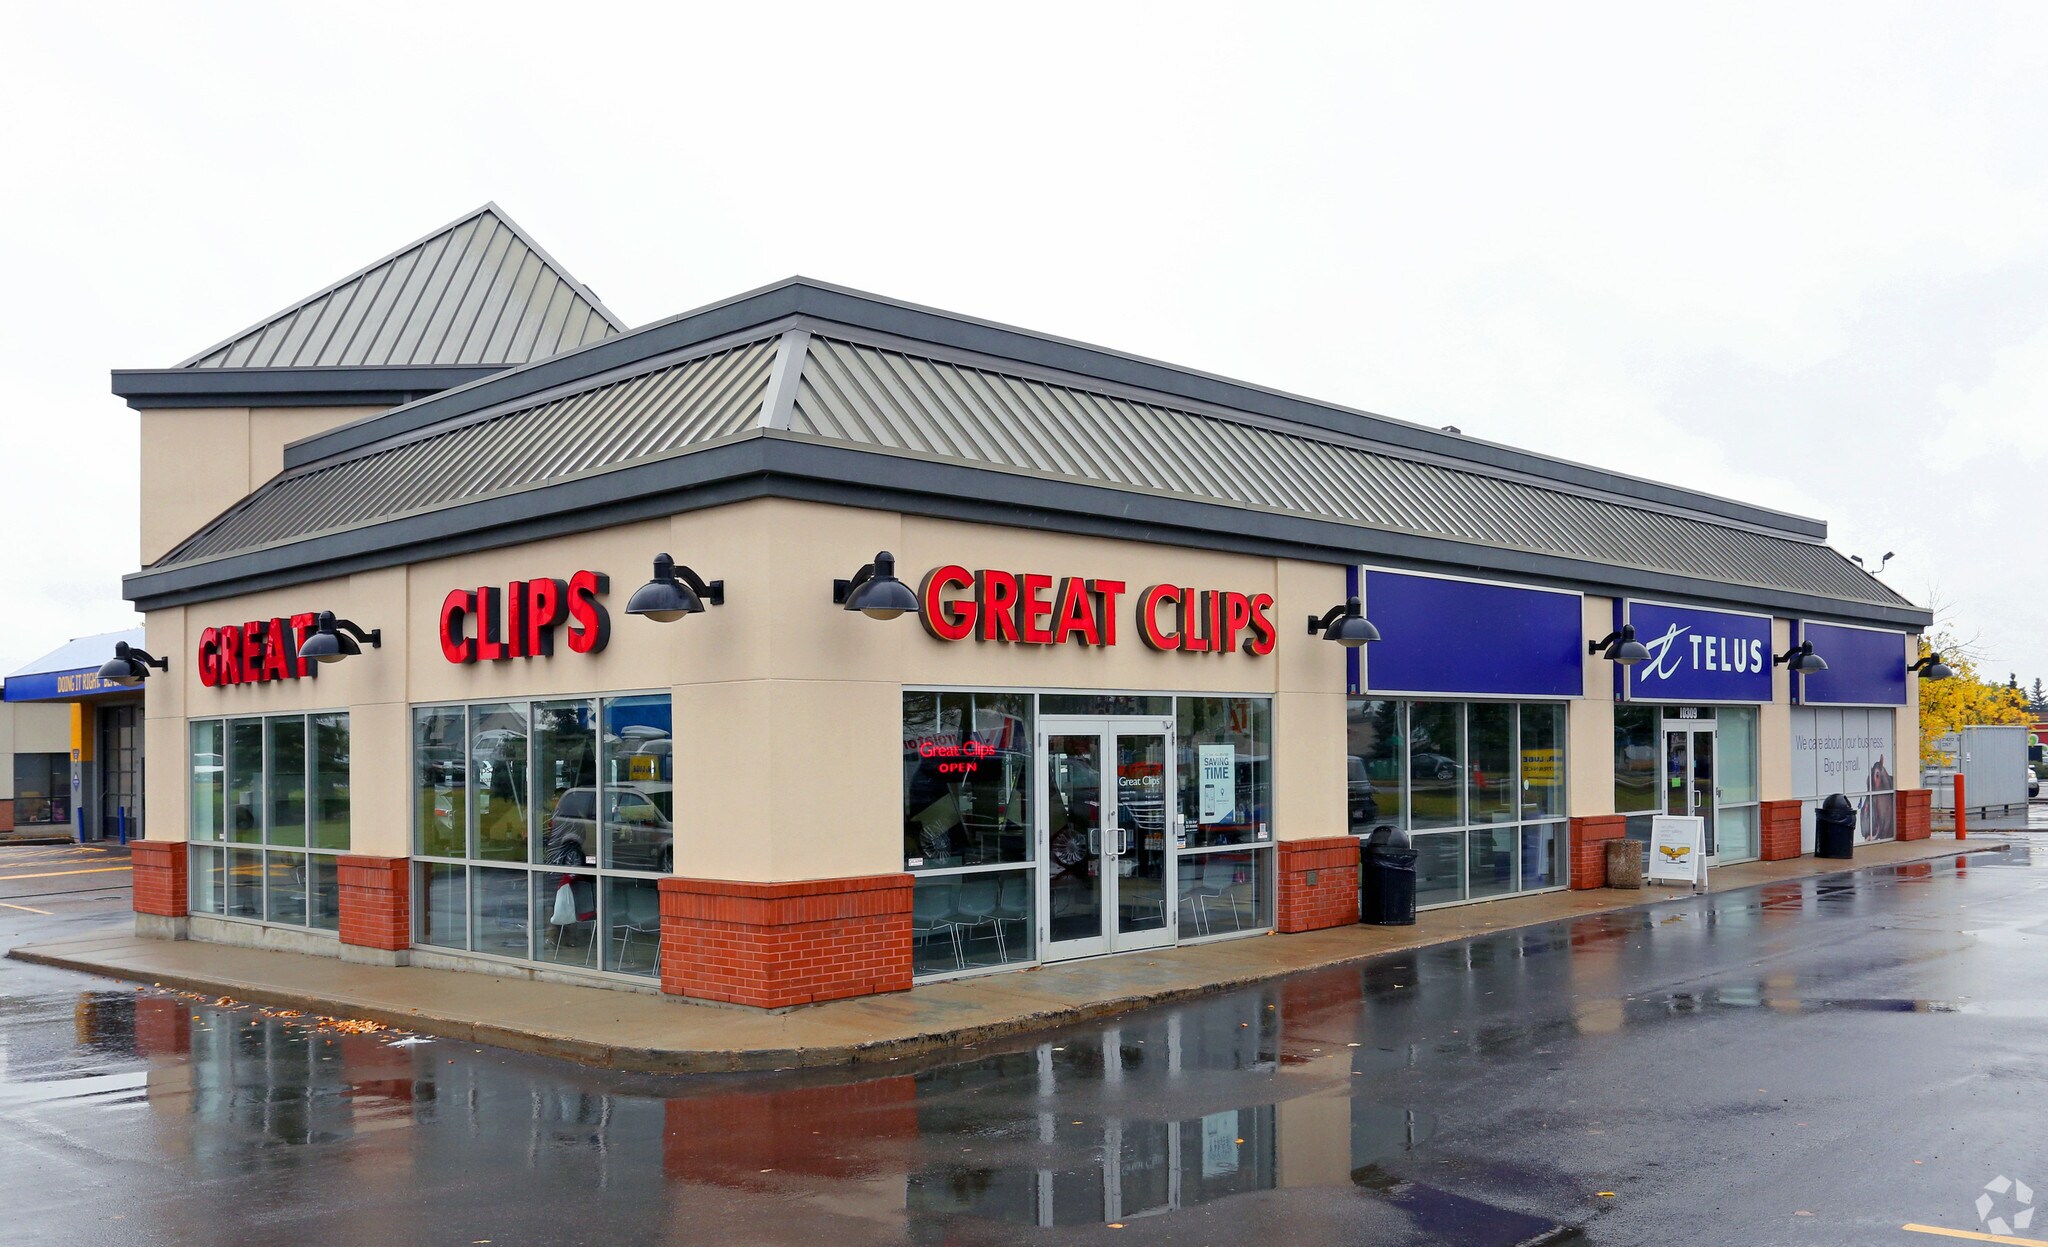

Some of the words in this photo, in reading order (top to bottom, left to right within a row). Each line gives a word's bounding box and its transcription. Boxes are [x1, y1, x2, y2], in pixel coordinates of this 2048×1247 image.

[919, 565, 1126, 647] GREAT
[1136, 584, 1277, 656] CLIPS
[199, 612, 318, 688] GREAT
[440, 570, 611, 664] CLIPS
[1690, 635, 1763, 674] TELUS
[57, 675, 75, 693] DOING
[75, 674, 81, 691] IT
[919, 741, 960, 758] Great
[963, 740, 997, 759] Clips
[1795, 735, 1807, 750] We
[1808, 738, 1823, 750] cae
[1824, 734, 1842, 750] about
[1844, 737, 1857, 750] our
[1857, 734, 1884, 748] busness.
[938, 762, 977, 773] OPEN
[1204, 757, 1229, 767] SAVING
[1824, 757, 1835, 776] Big
[1118, 776, 1142, 787] Great
[1142, 775, 1161, 788] Clips
[1204, 767, 1230, 779] TIME
